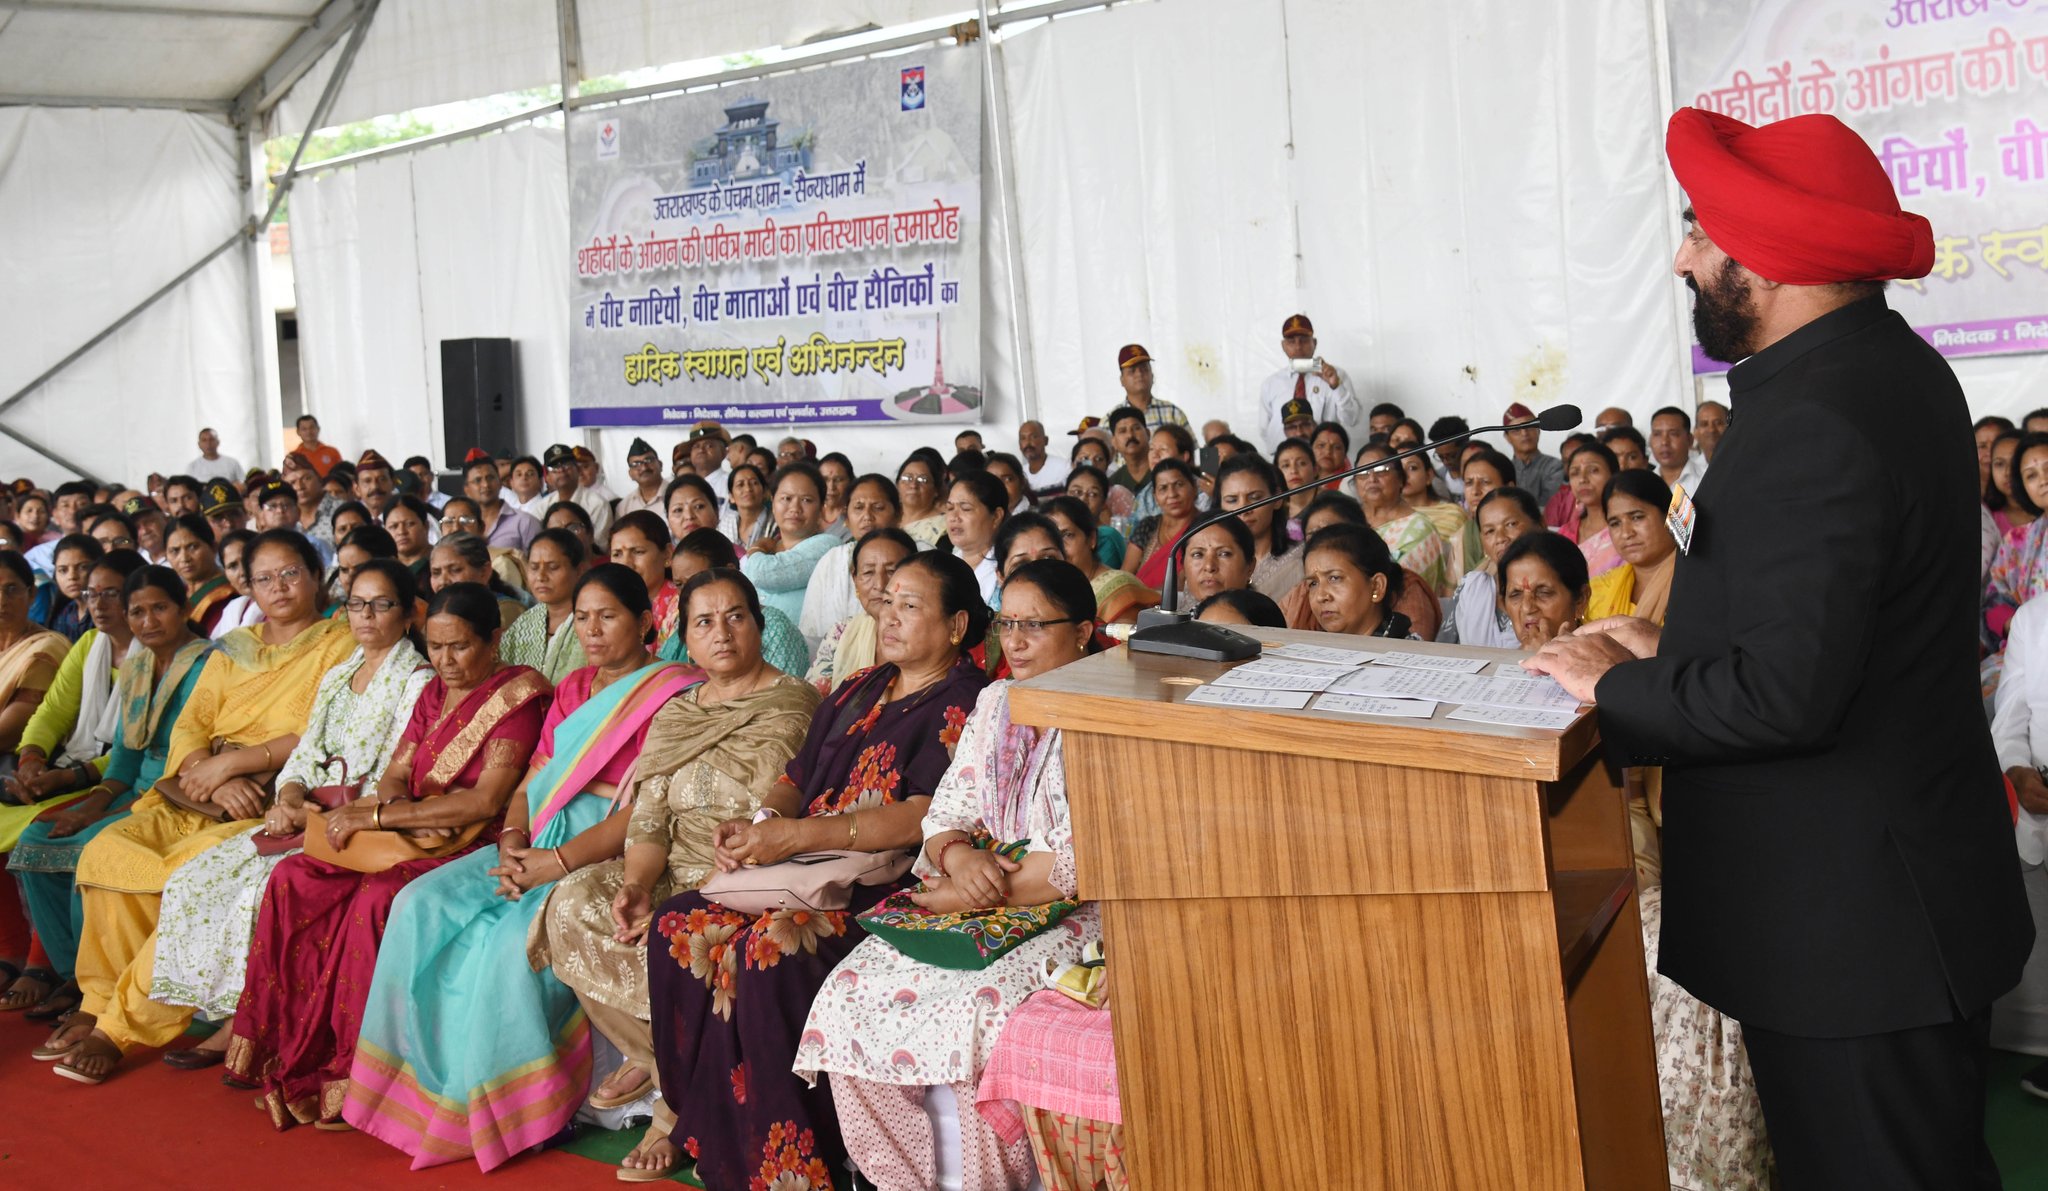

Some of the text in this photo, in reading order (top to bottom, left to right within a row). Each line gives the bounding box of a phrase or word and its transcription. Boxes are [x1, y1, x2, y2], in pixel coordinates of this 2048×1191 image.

[1797, 59, 1836, 114] के
[1845, 44, 1955, 112] आंगन
[1961, 27, 2017, 92] की
[653, 191, 707, 221] उत्तराखण्ड
[709, 182, 721, 214] के
[724, 178, 753, 212] पंचम
[756, 181, 780, 209] धाम
[795, 170, 851, 203] सैन्यधाम
[853, 160, 866, 195] में
[578, 199, 960, 275] शहीदों के आंगन की पवित्र माटी का प्रतिस्थापन समारोह
[600, 292, 625, 328] वीर
[628, 286, 688, 329] नारियों,
[693, 284, 720, 322] वीर
[725, 276, 790, 320] माताओं
[796, 273, 821, 315] एवं
[827, 272, 859, 312] वीर
[864, 262, 935, 309] सैनिकों
[940, 281, 959, 304] का
[683, 348, 749, 382] स्वागत
[751, 335, 786, 386] एवं
[787, 332, 906, 378] अभिनन्दन
[1933, 329, 1996, 348] निवेदक
